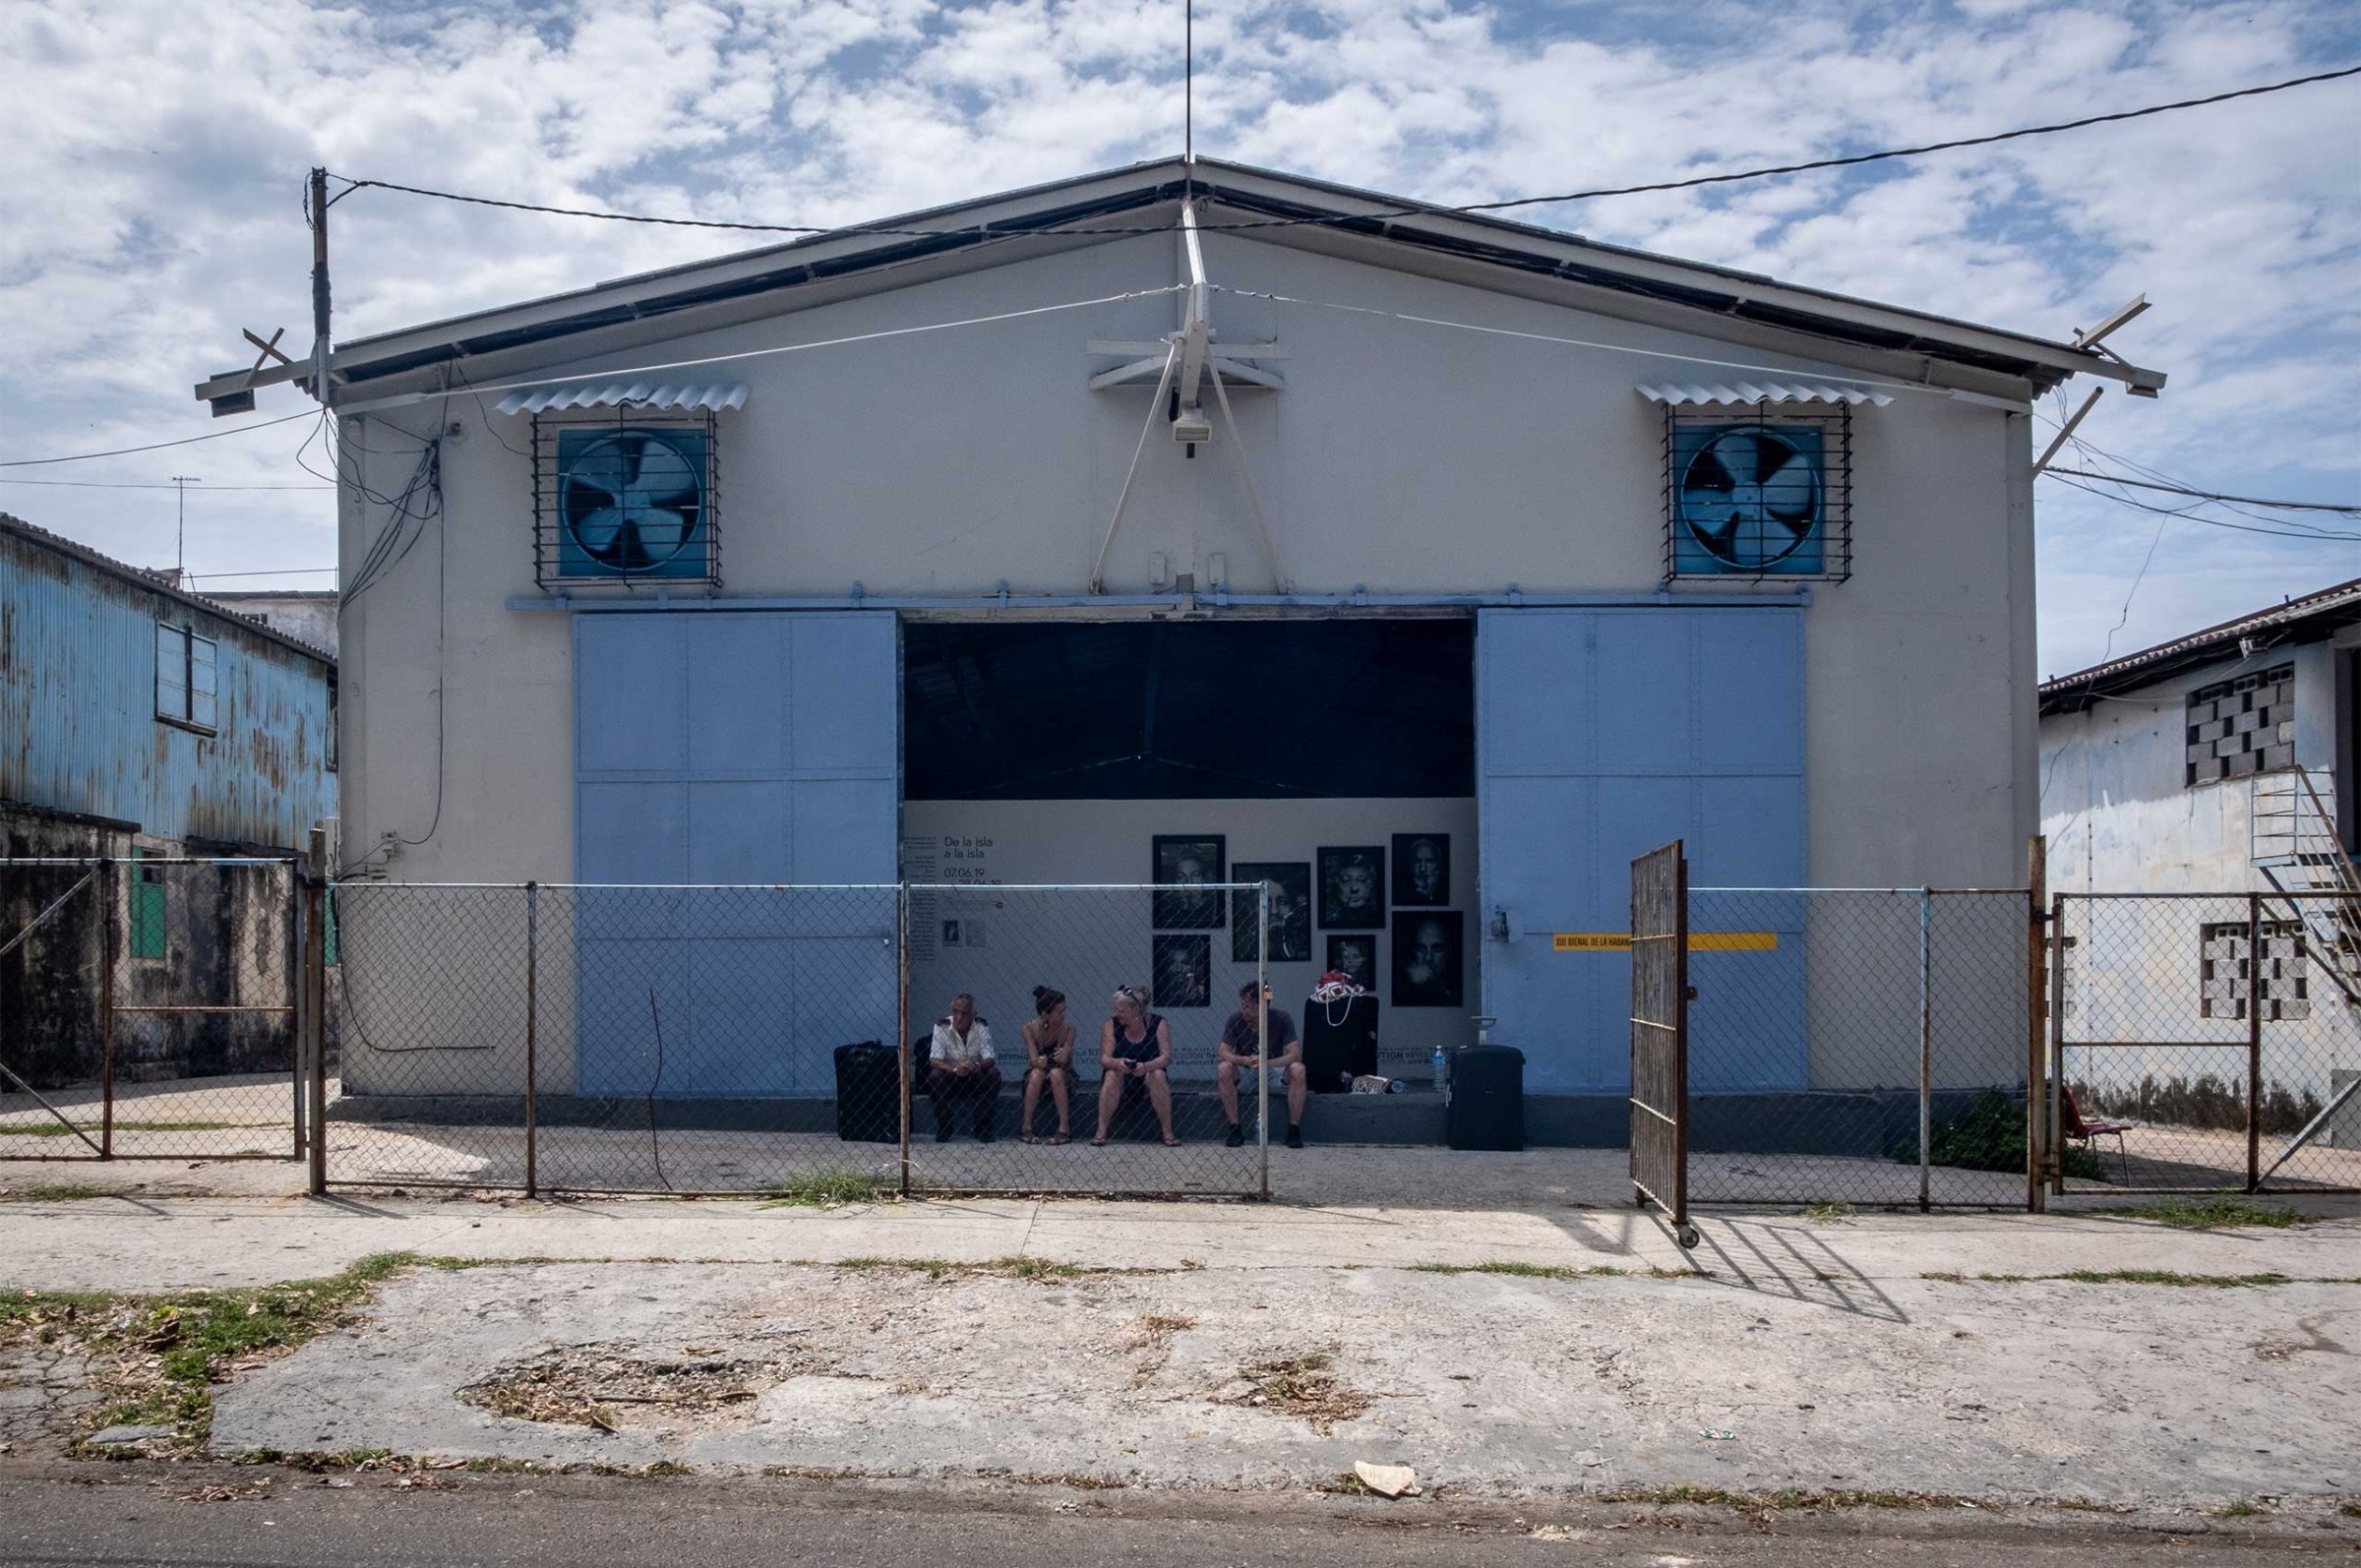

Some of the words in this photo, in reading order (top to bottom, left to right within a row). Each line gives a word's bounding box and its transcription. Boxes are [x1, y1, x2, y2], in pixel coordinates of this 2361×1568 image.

[944, 836, 959, 847] De
[963, 836, 972, 847] la
[975, 836, 993, 847] isla
[954, 848, 963, 859] la
[967, 848, 984, 859] isla
